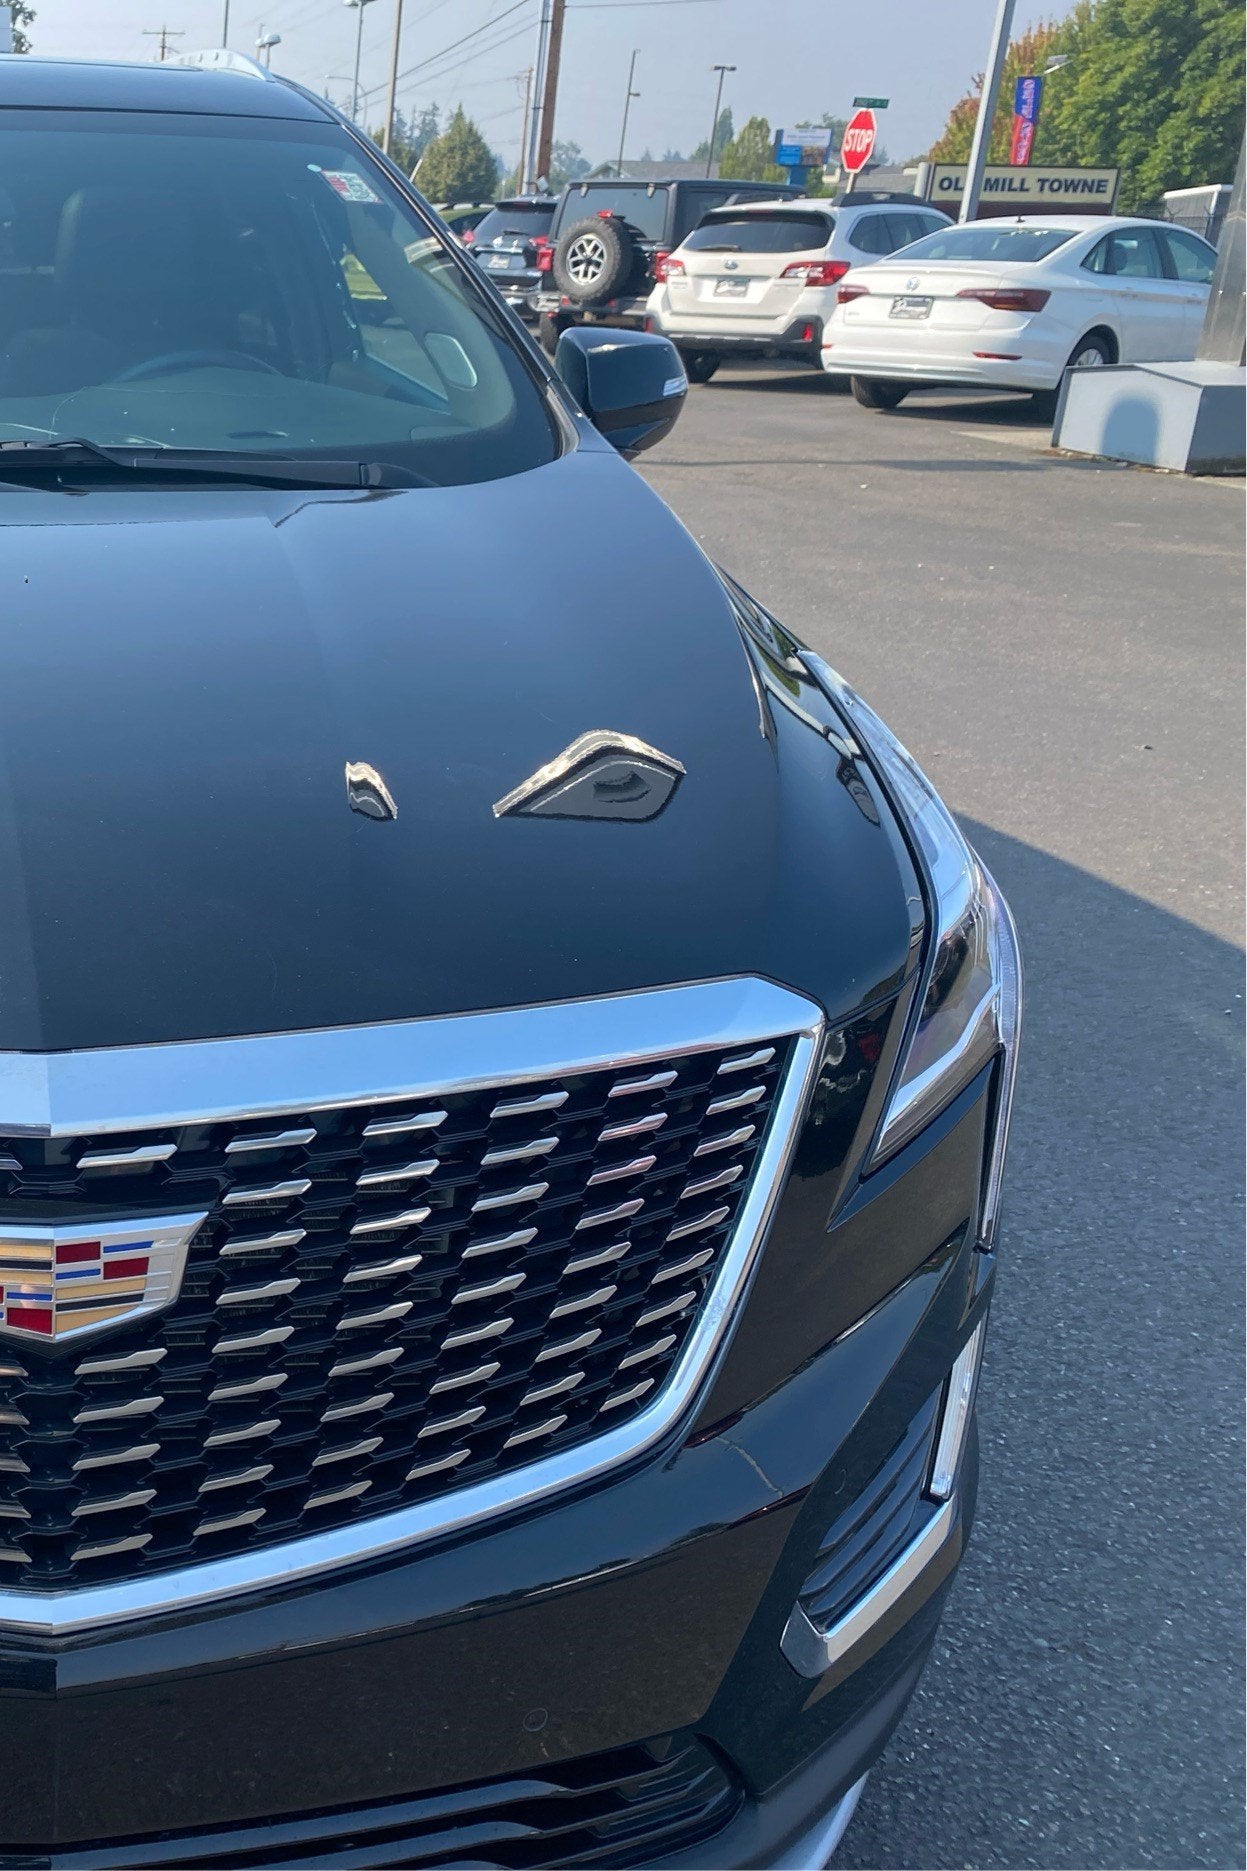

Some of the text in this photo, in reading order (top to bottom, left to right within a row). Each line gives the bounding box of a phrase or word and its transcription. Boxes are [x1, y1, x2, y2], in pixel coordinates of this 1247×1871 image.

[844, 128, 873, 152] STOP
[938, 176, 1109, 194] OL MILL TOWNE
